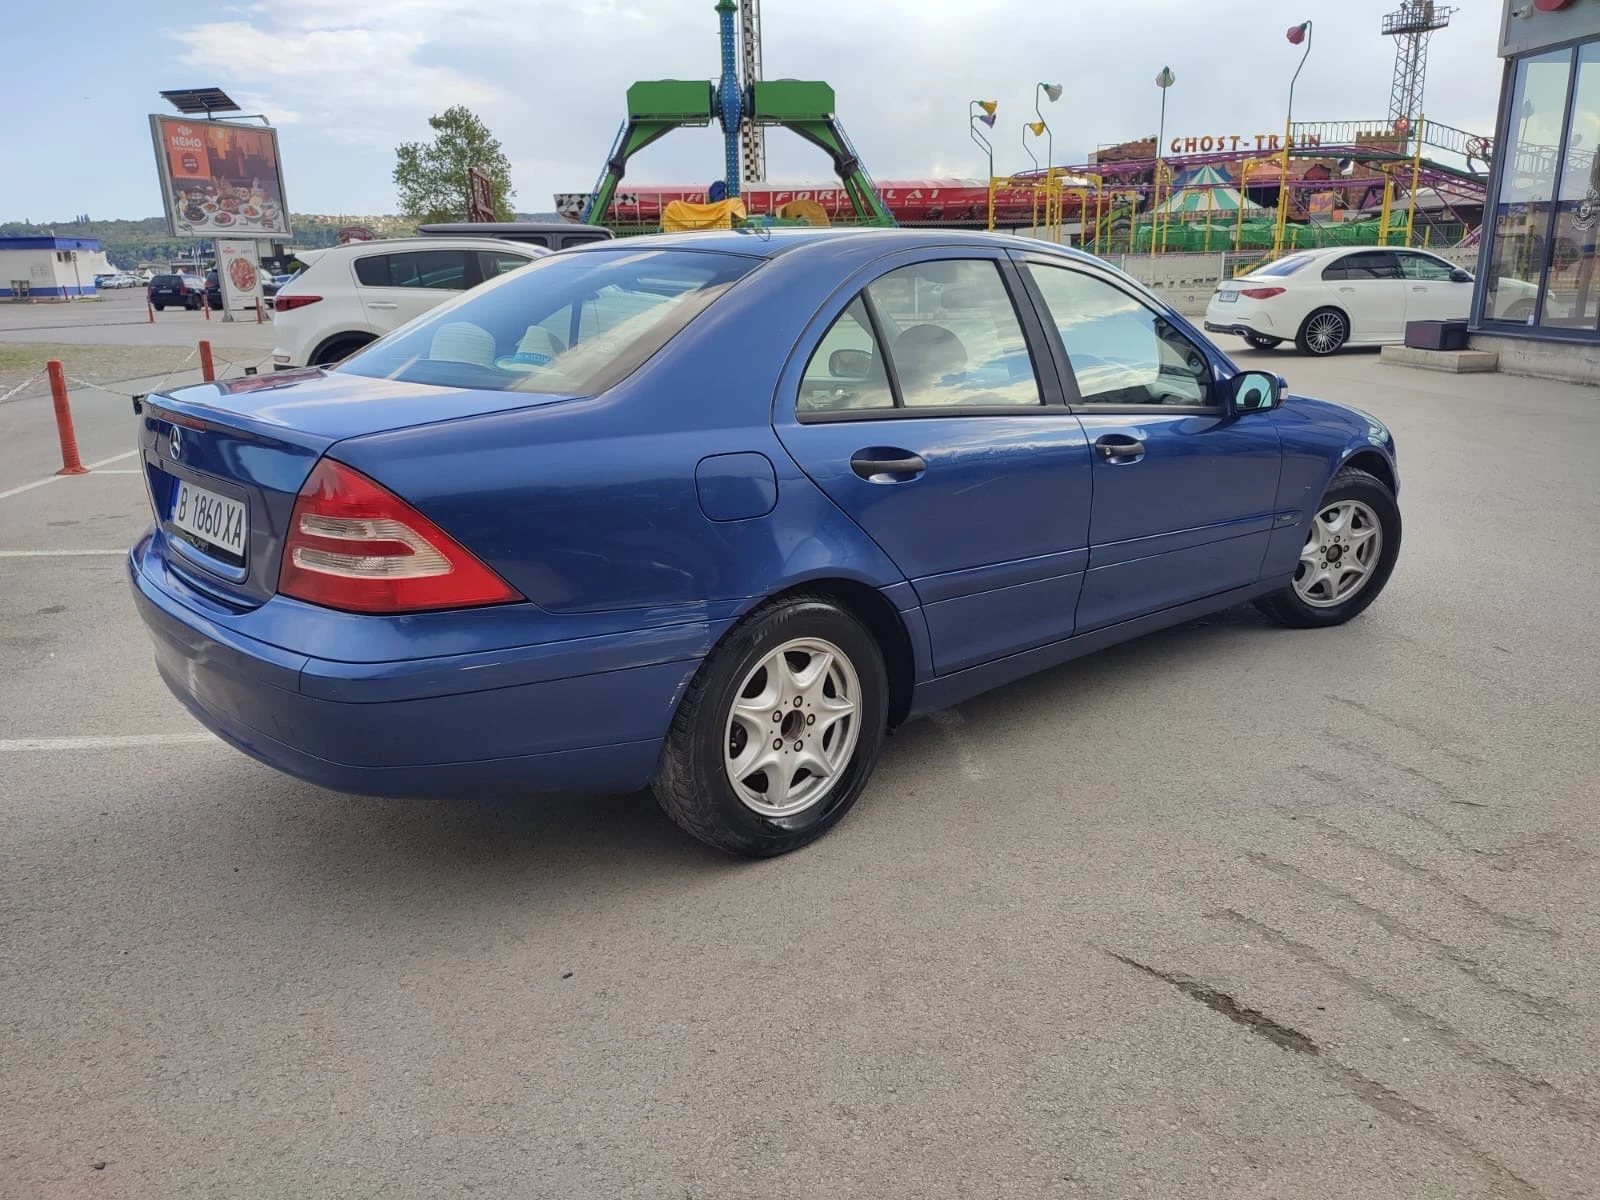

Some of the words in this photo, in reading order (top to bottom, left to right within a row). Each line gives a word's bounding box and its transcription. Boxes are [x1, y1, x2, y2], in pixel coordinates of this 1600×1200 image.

[171, 136, 202, 148] NEMO
[179, 487, 188, 522] B
[193, 493, 222, 538] 1860
[222, 504, 243, 549] XA
